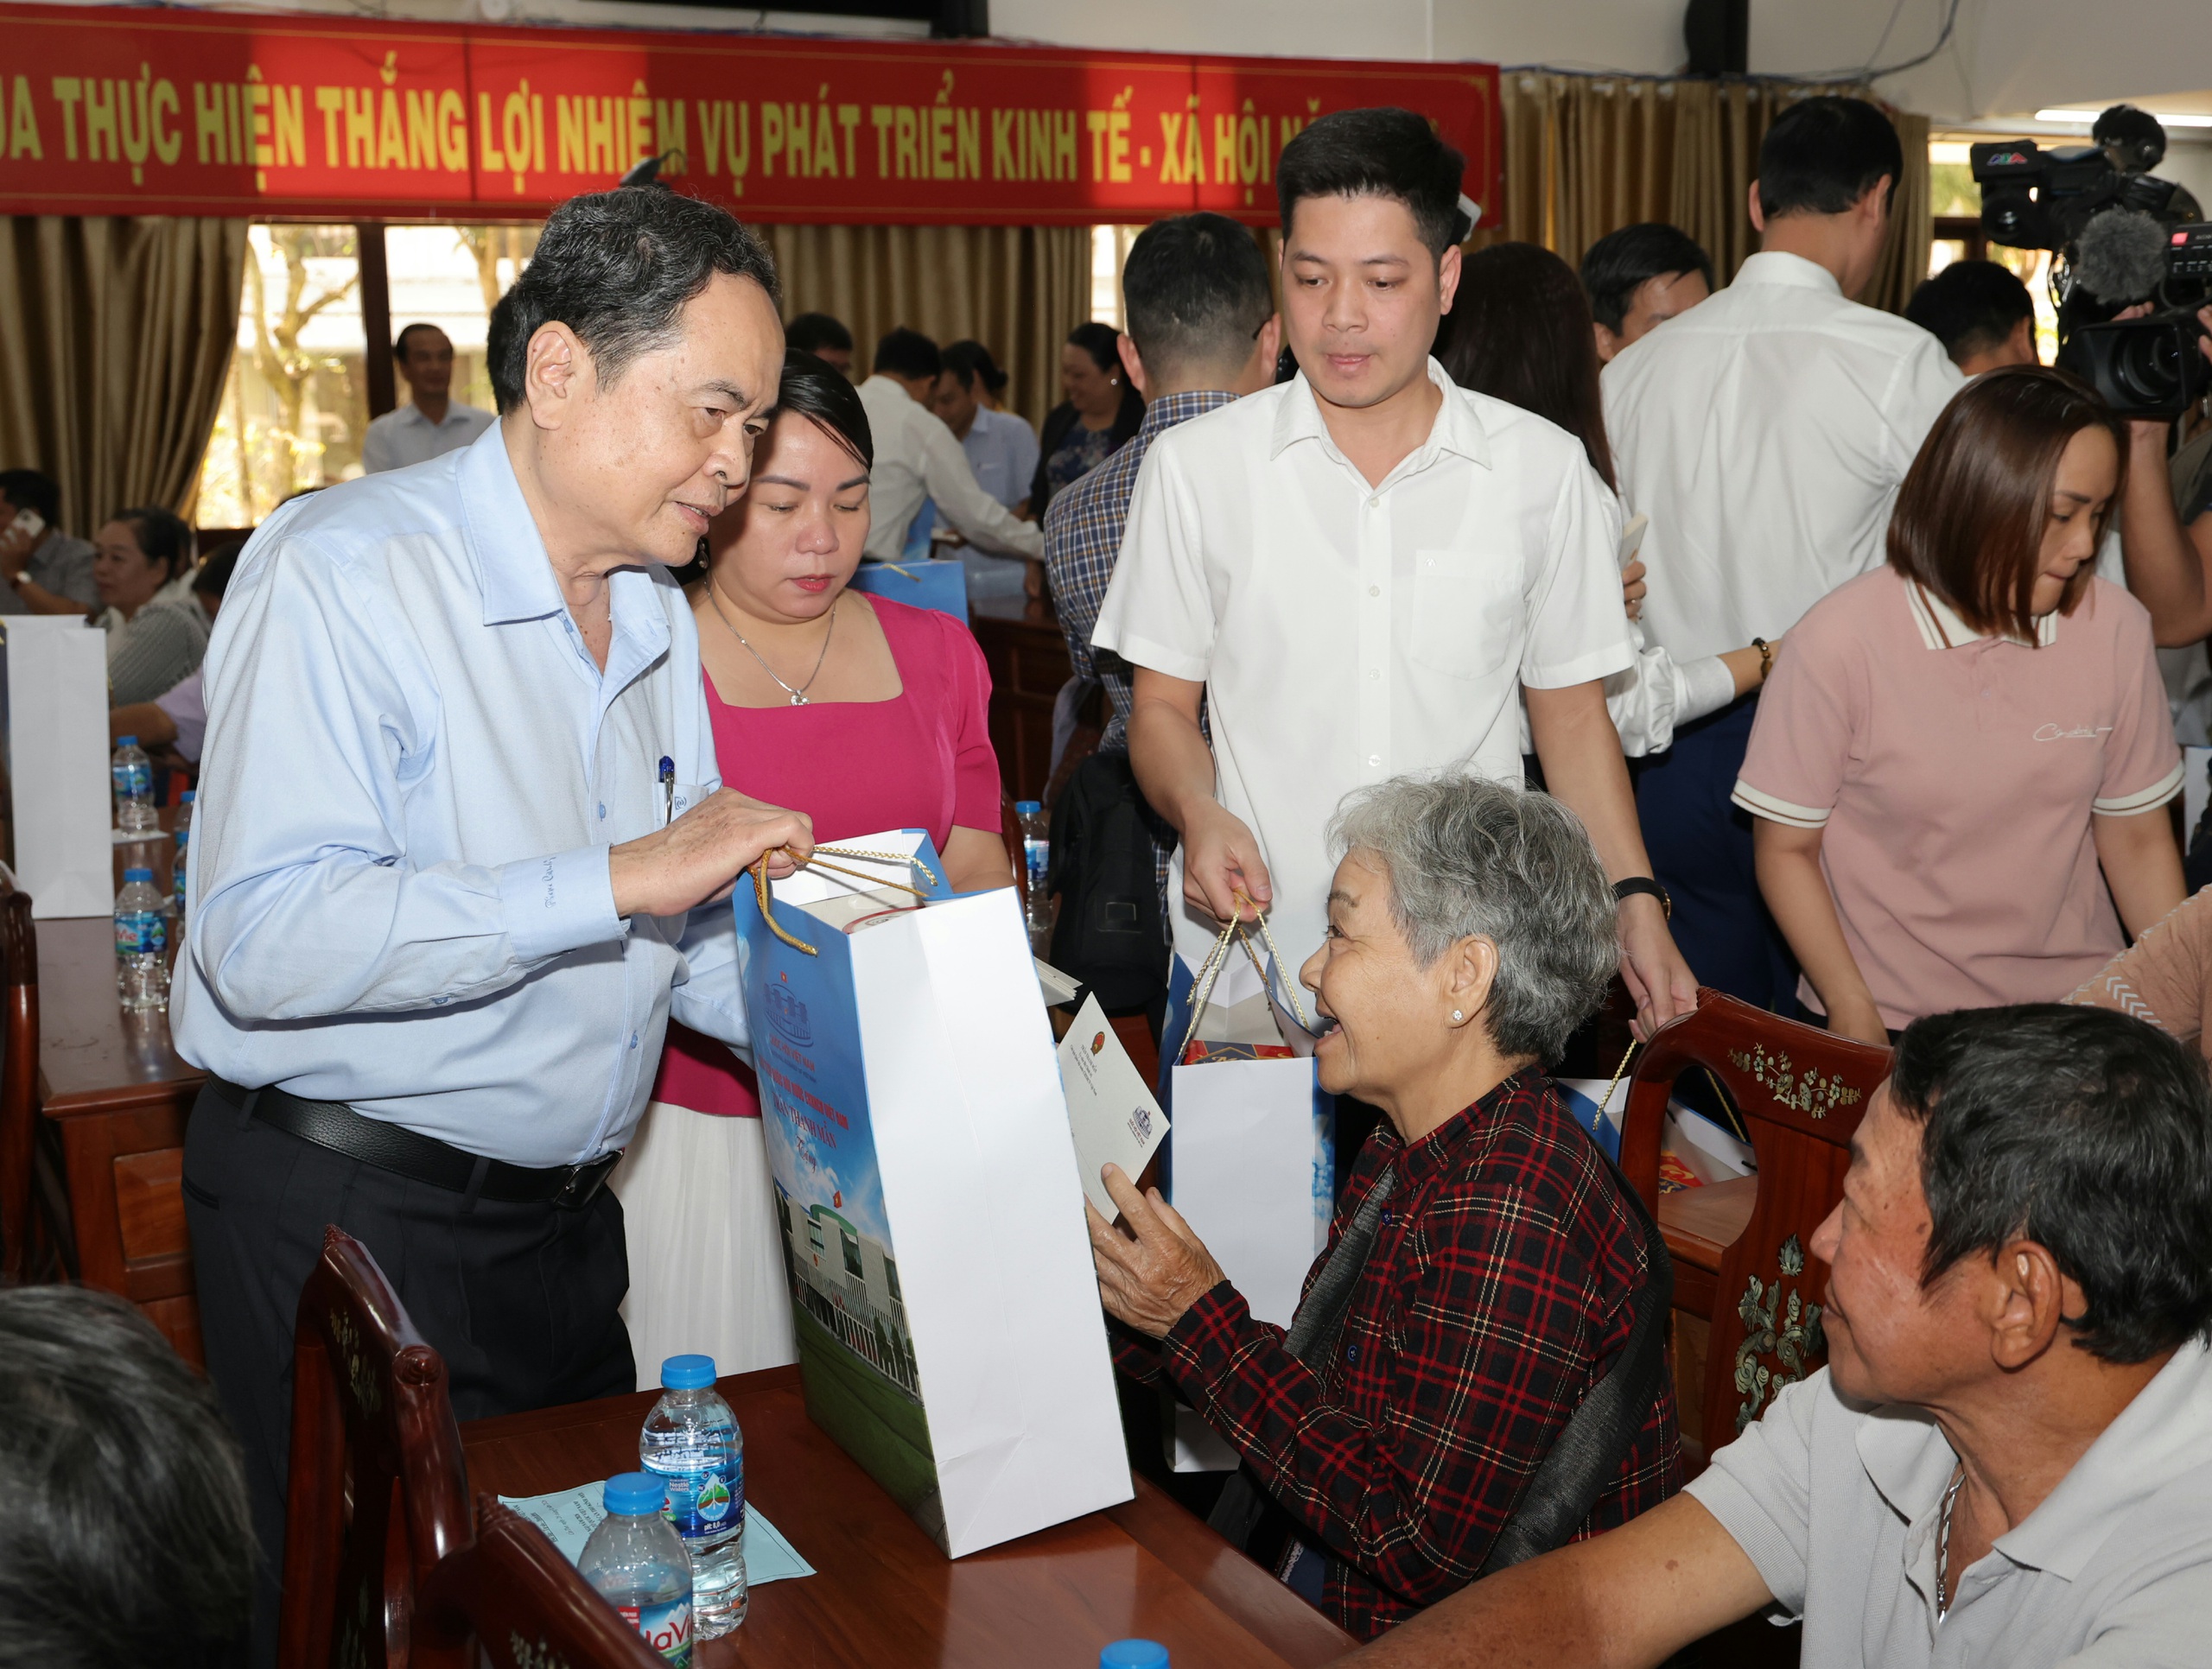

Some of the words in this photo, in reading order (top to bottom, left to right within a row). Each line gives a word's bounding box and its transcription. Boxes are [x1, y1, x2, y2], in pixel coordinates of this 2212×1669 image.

[0, 74, 43, 161] A
[52, 62, 181, 185] THỰC
[194, 65, 306, 191] HIỆN
[315, 51, 469, 172] THẮNG
[478, 79, 544, 194] LỢI
[698, 100, 750, 196] VỤ
[761, 84, 861, 177] PHÁT
[871, 70, 981, 179] TRIỂN
[992, 109, 1077, 181] KINH
[1086, 86, 1134, 183] TẾ
[1214, 98, 1270, 205] HỘI
